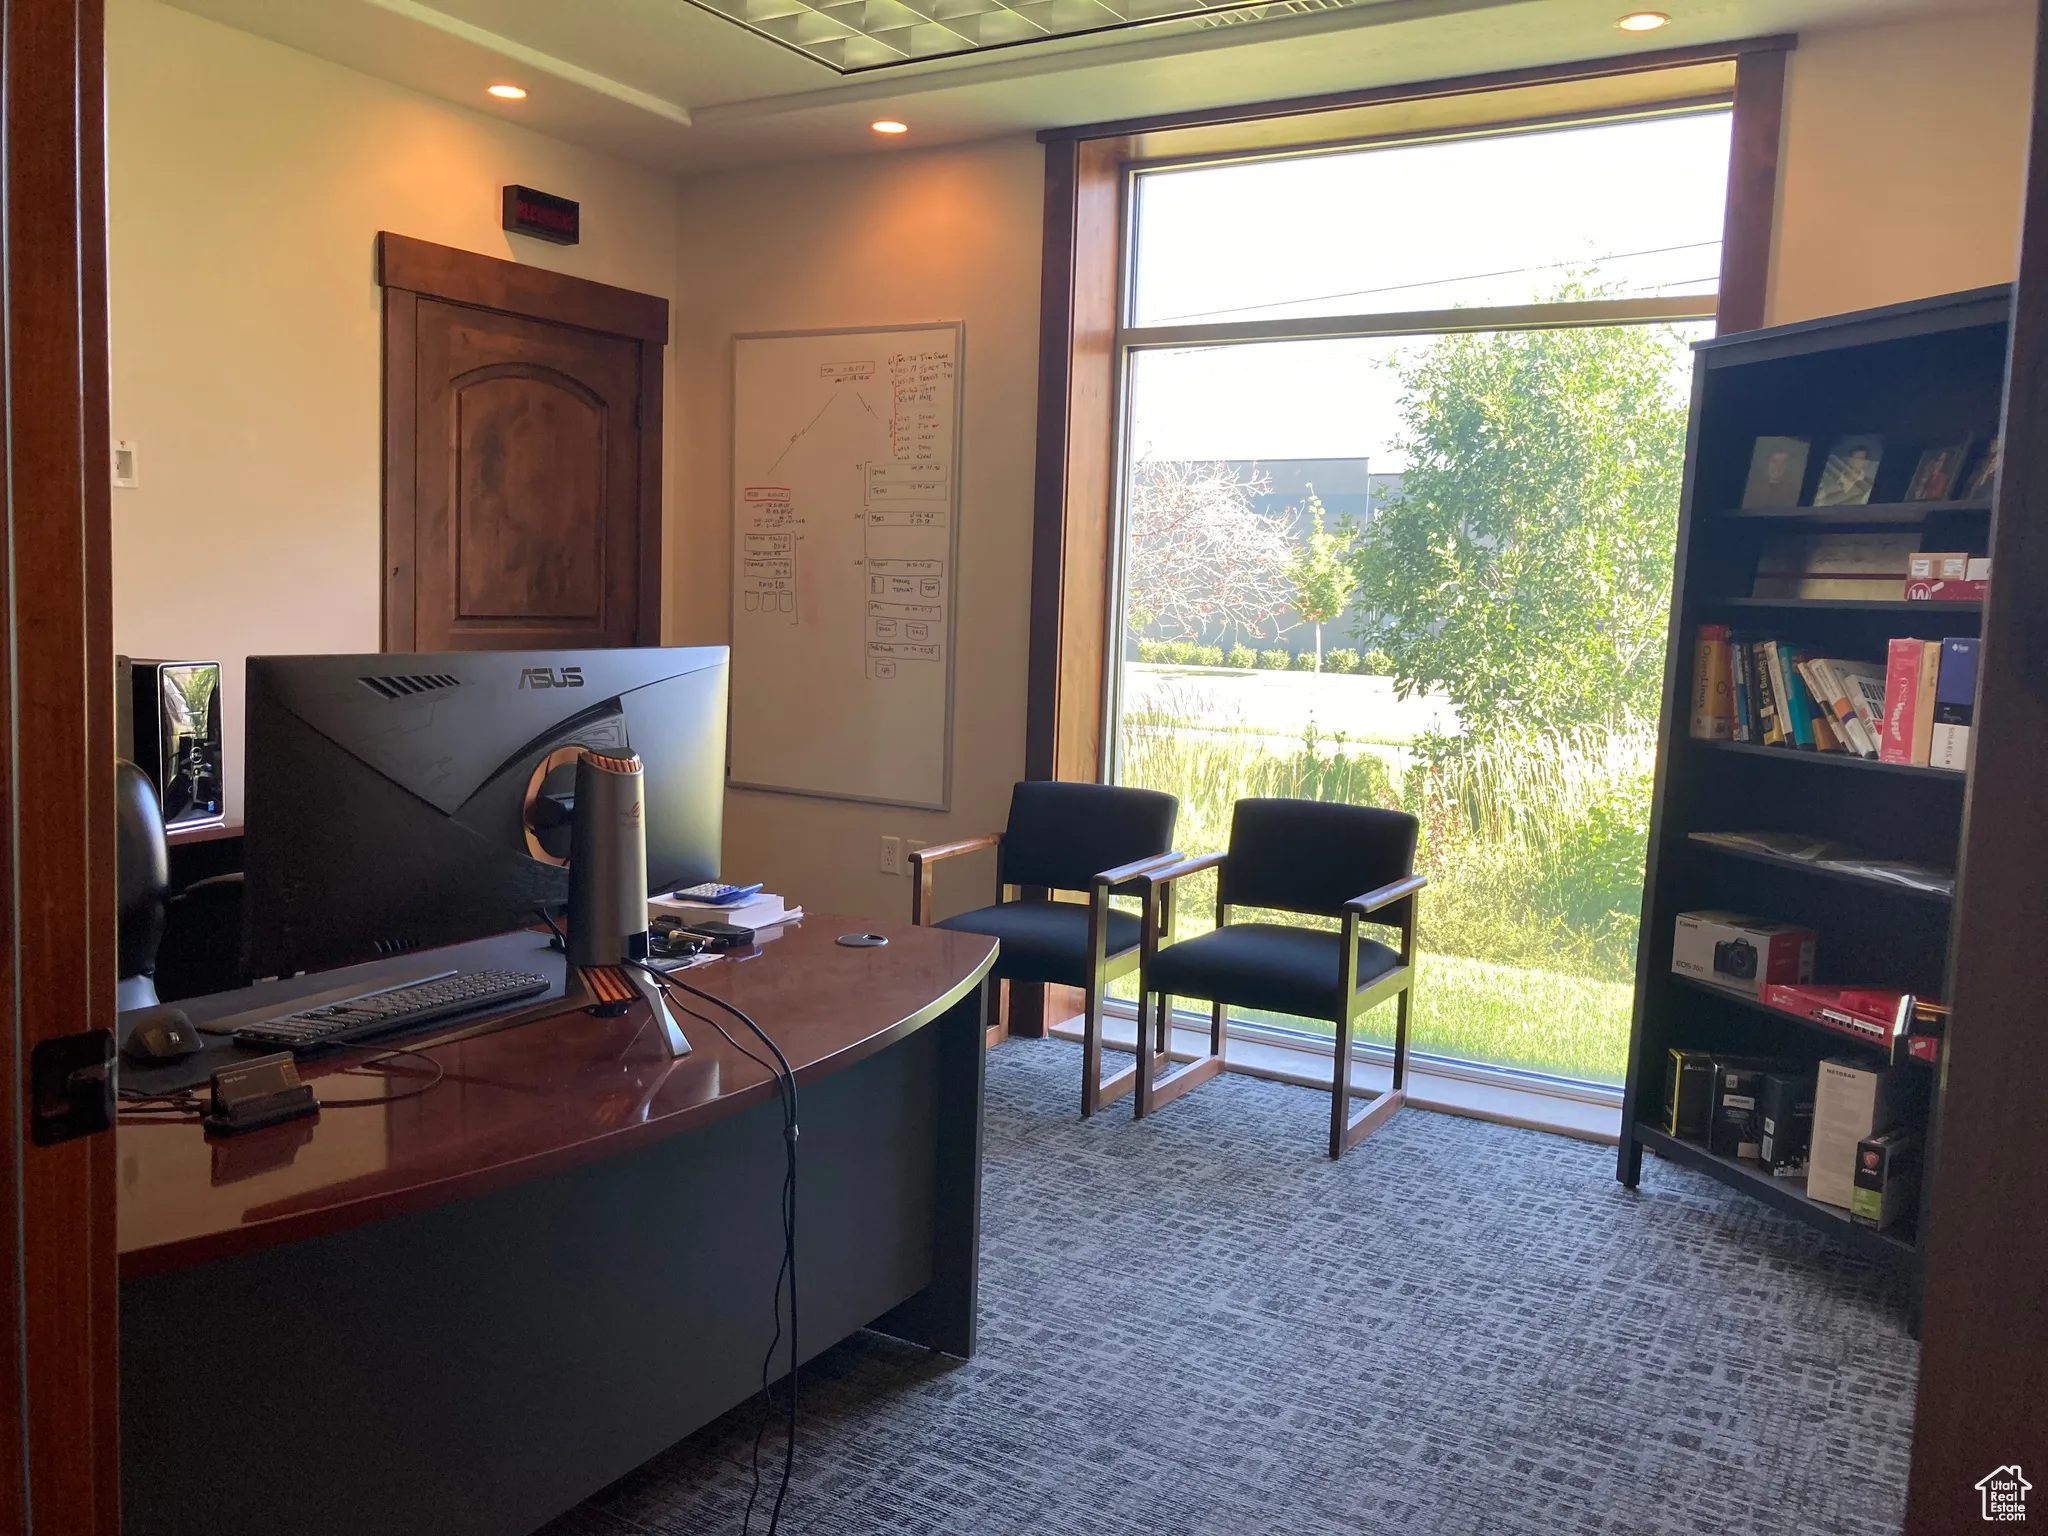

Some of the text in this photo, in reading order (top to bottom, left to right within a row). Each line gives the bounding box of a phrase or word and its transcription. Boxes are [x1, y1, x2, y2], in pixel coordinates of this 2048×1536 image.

[518, 667, 585, 690] ASUS
[1698, 645, 1712, 710] OpenLinux
[1758, 660, 1769, 689] Spring
[1890, 701, 1906, 741] WARP
[1946, 727, 1955, 758] SOLARIS
[1679, 920, 1698, 929] Canon
[1675, 960, 1692, 970] EOS
[1826, 1069, 1857, 1079] NETGEAR
[1861, 1167, 1878, 1176] msi
